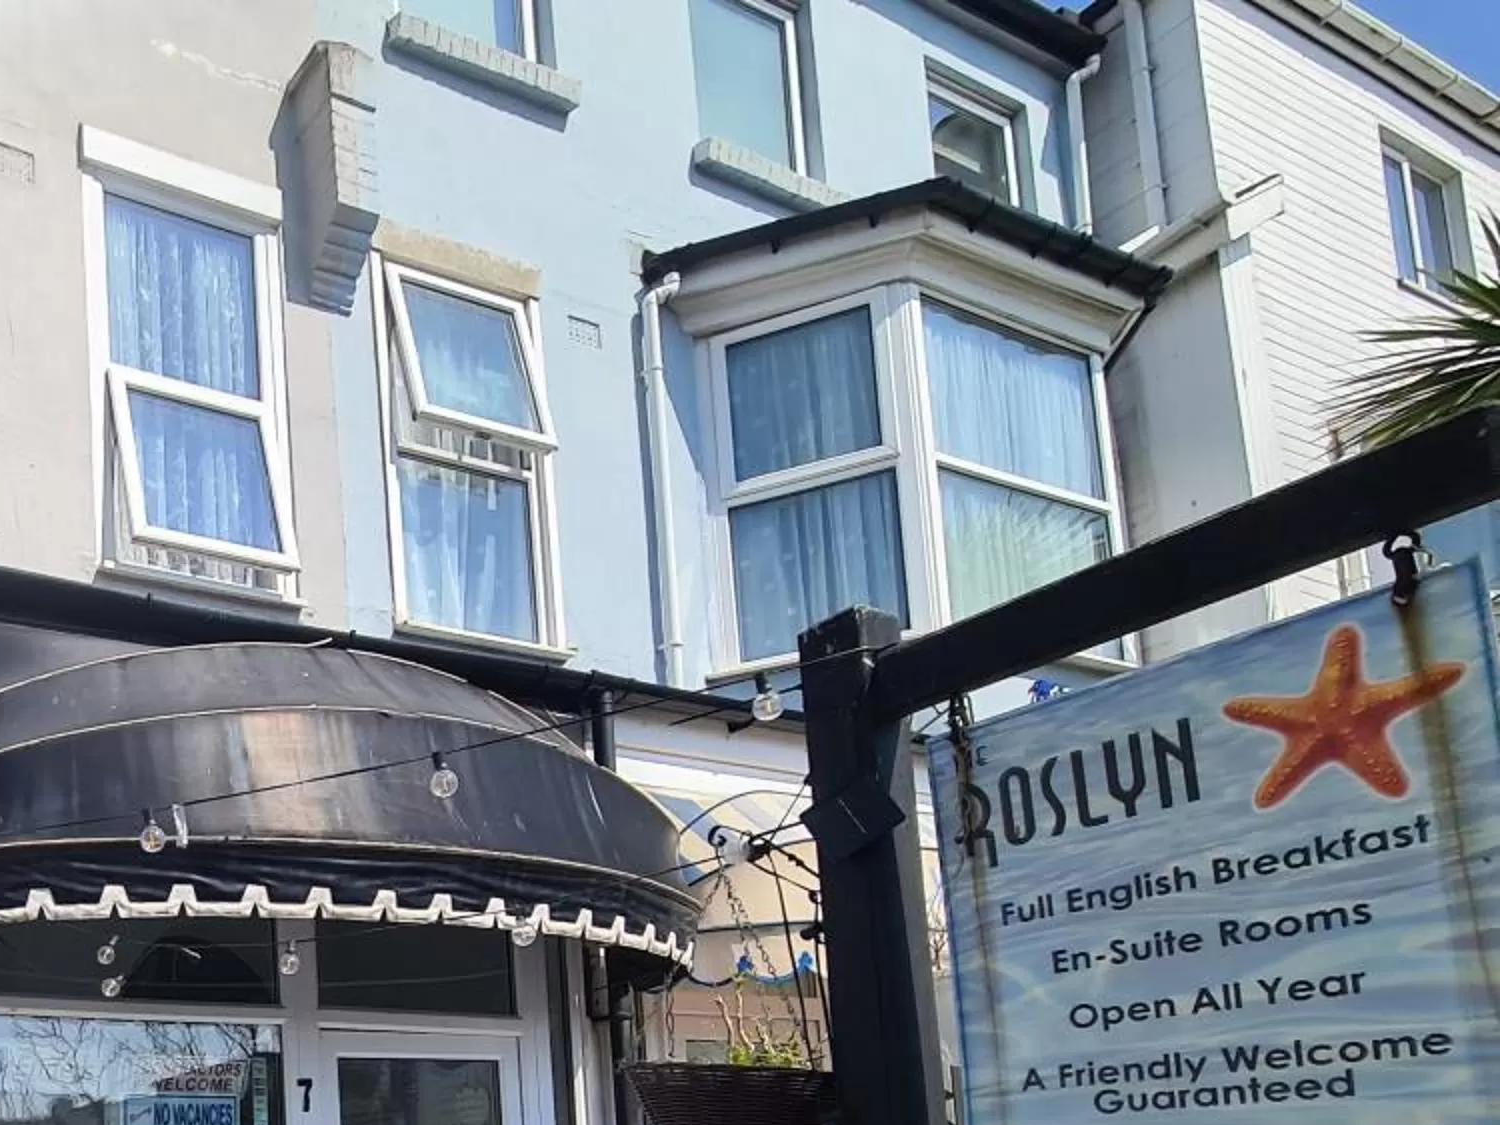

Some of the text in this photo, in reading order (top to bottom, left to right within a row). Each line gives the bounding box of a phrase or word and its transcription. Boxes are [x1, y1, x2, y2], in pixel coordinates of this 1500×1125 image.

[963, 717, 1201, 867] ROSLYN
[1000, 814, 1431, 927] Full English Breakfast
[1052, 902, 1373, 974] En-Suite Rooms
[1069, 971, 1366, 1032] Open All Year
[1021, 1031, 1453, 1093] A Friendly Welcome
[1094, 1069, 1356, 1114] Guaranteed
[297, 1078, 312, 1112] 7
